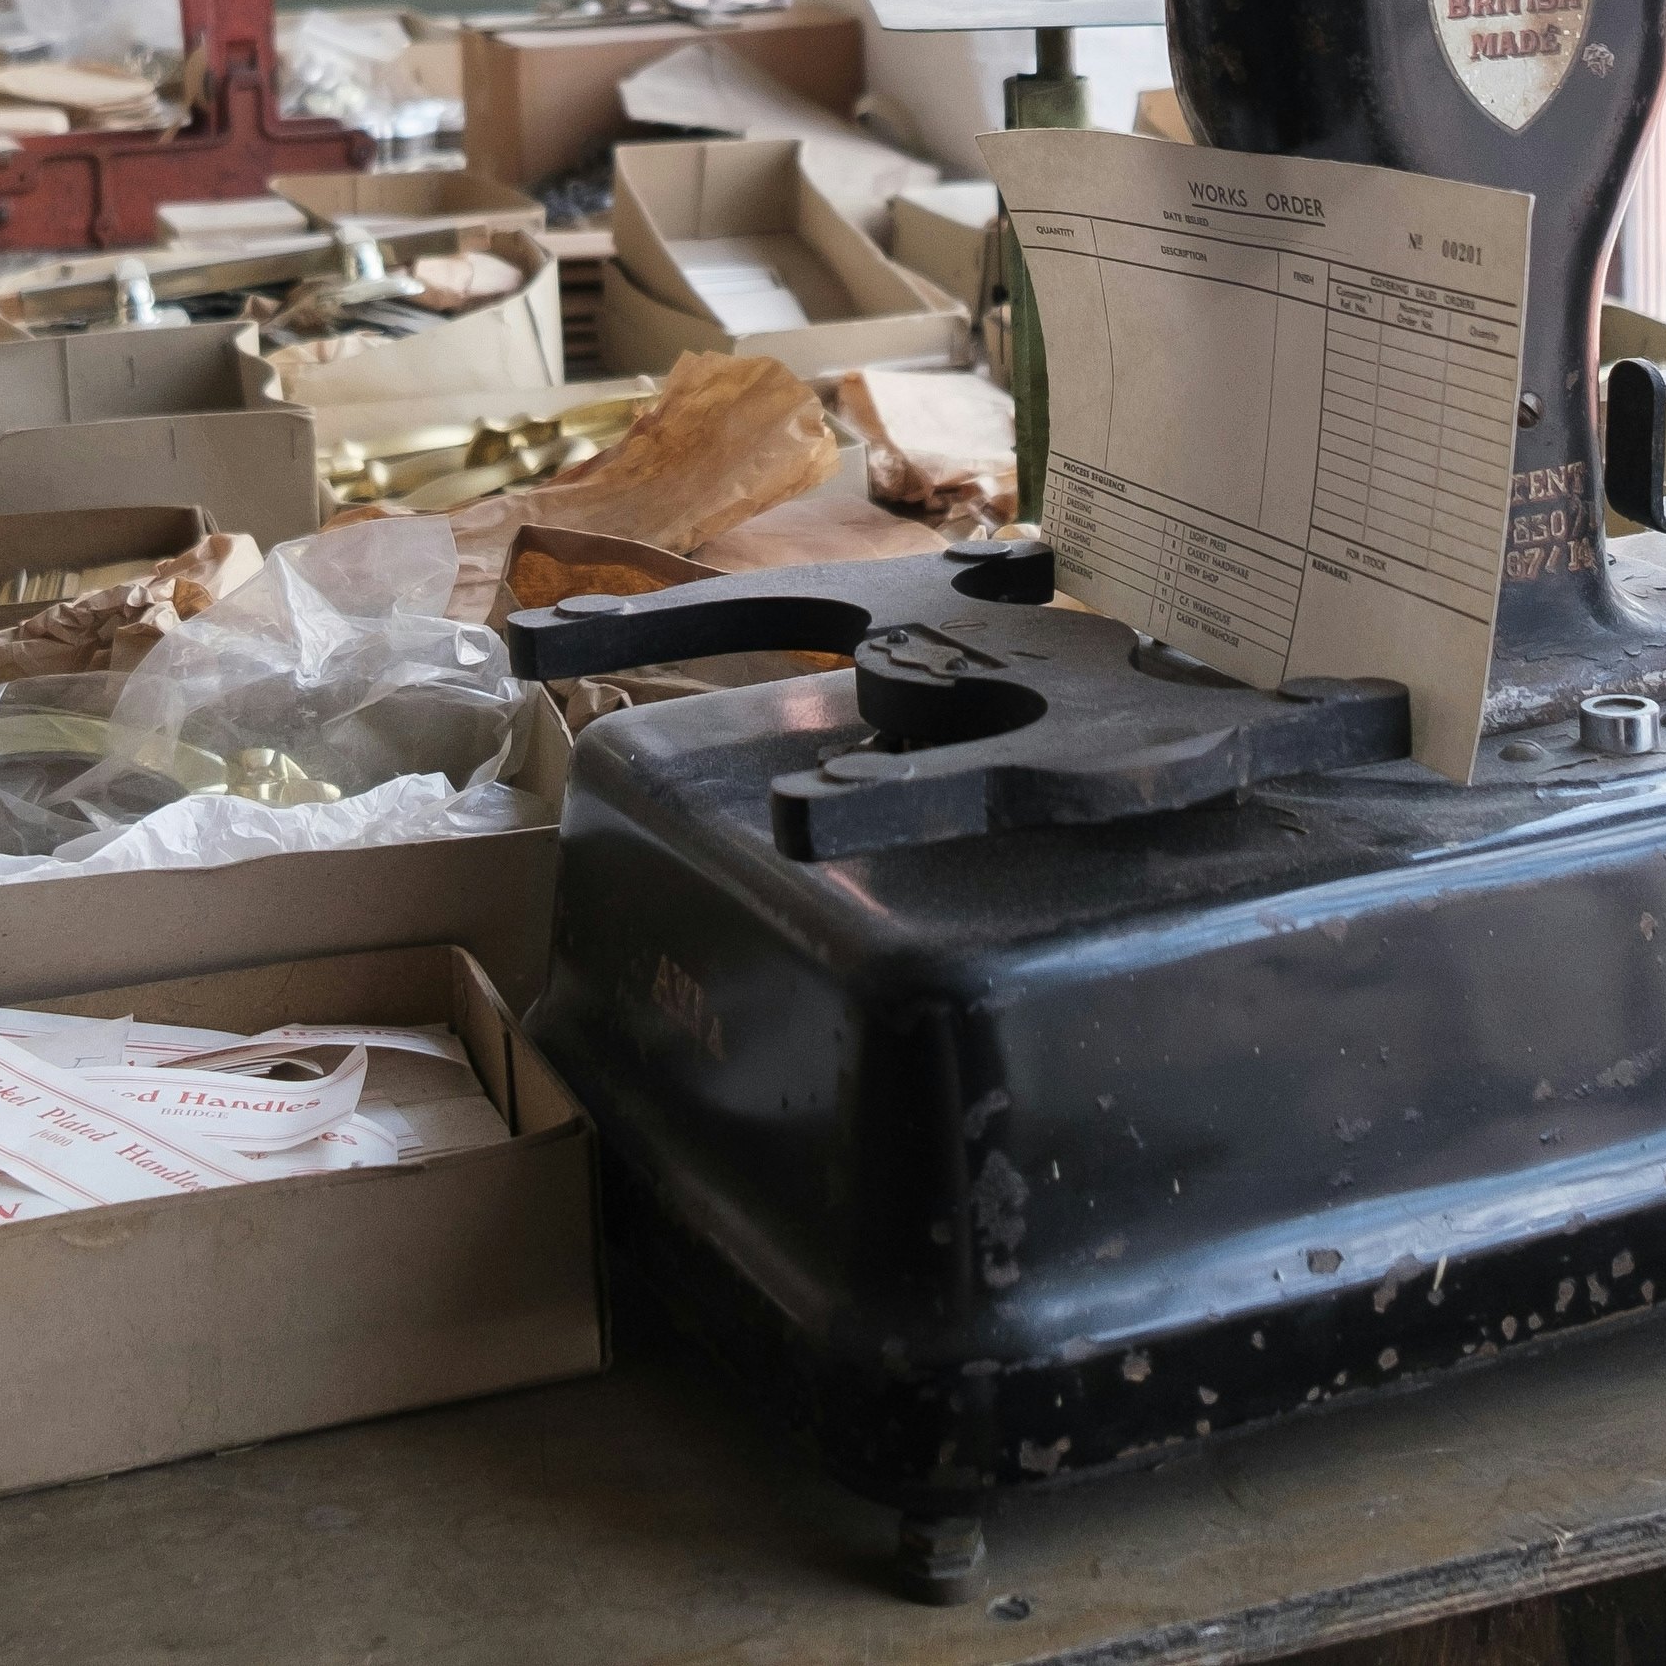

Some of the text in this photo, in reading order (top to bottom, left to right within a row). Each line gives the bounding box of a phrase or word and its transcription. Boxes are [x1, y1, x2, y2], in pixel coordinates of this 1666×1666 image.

[1469, 24, 1562, 62] MADE
[1188, 181, 1325, 218] WORKS ORDER
[1163, 210, 1182, 223] DATE
[1036, 225, 1075, 238] QUANTITY
[1160, 245, 1207, 262] DESCRIPTION
[1441, 239, 1483, 266] 00201
[1063, 461, 1089, 478] PROCESS
[1061, 542, 1084, 559] PLATING
[1189, 530, 1208, 544] LIGHT
[1210, 537, 1227, 553] PRESS
[1187, 546, 1209, 563] CASKET
[1193, 601, 1231, 626] WAREHOUSE
[1176, 612, 1199, 630] CASKET
[1201, 622, 1239, 648] WAREHOUSE
[160, 1107, 229, 1120] BRIDGE
[177, 1091, 322, 1114] Handles
[36, 1106, 118, 1144] Plated
